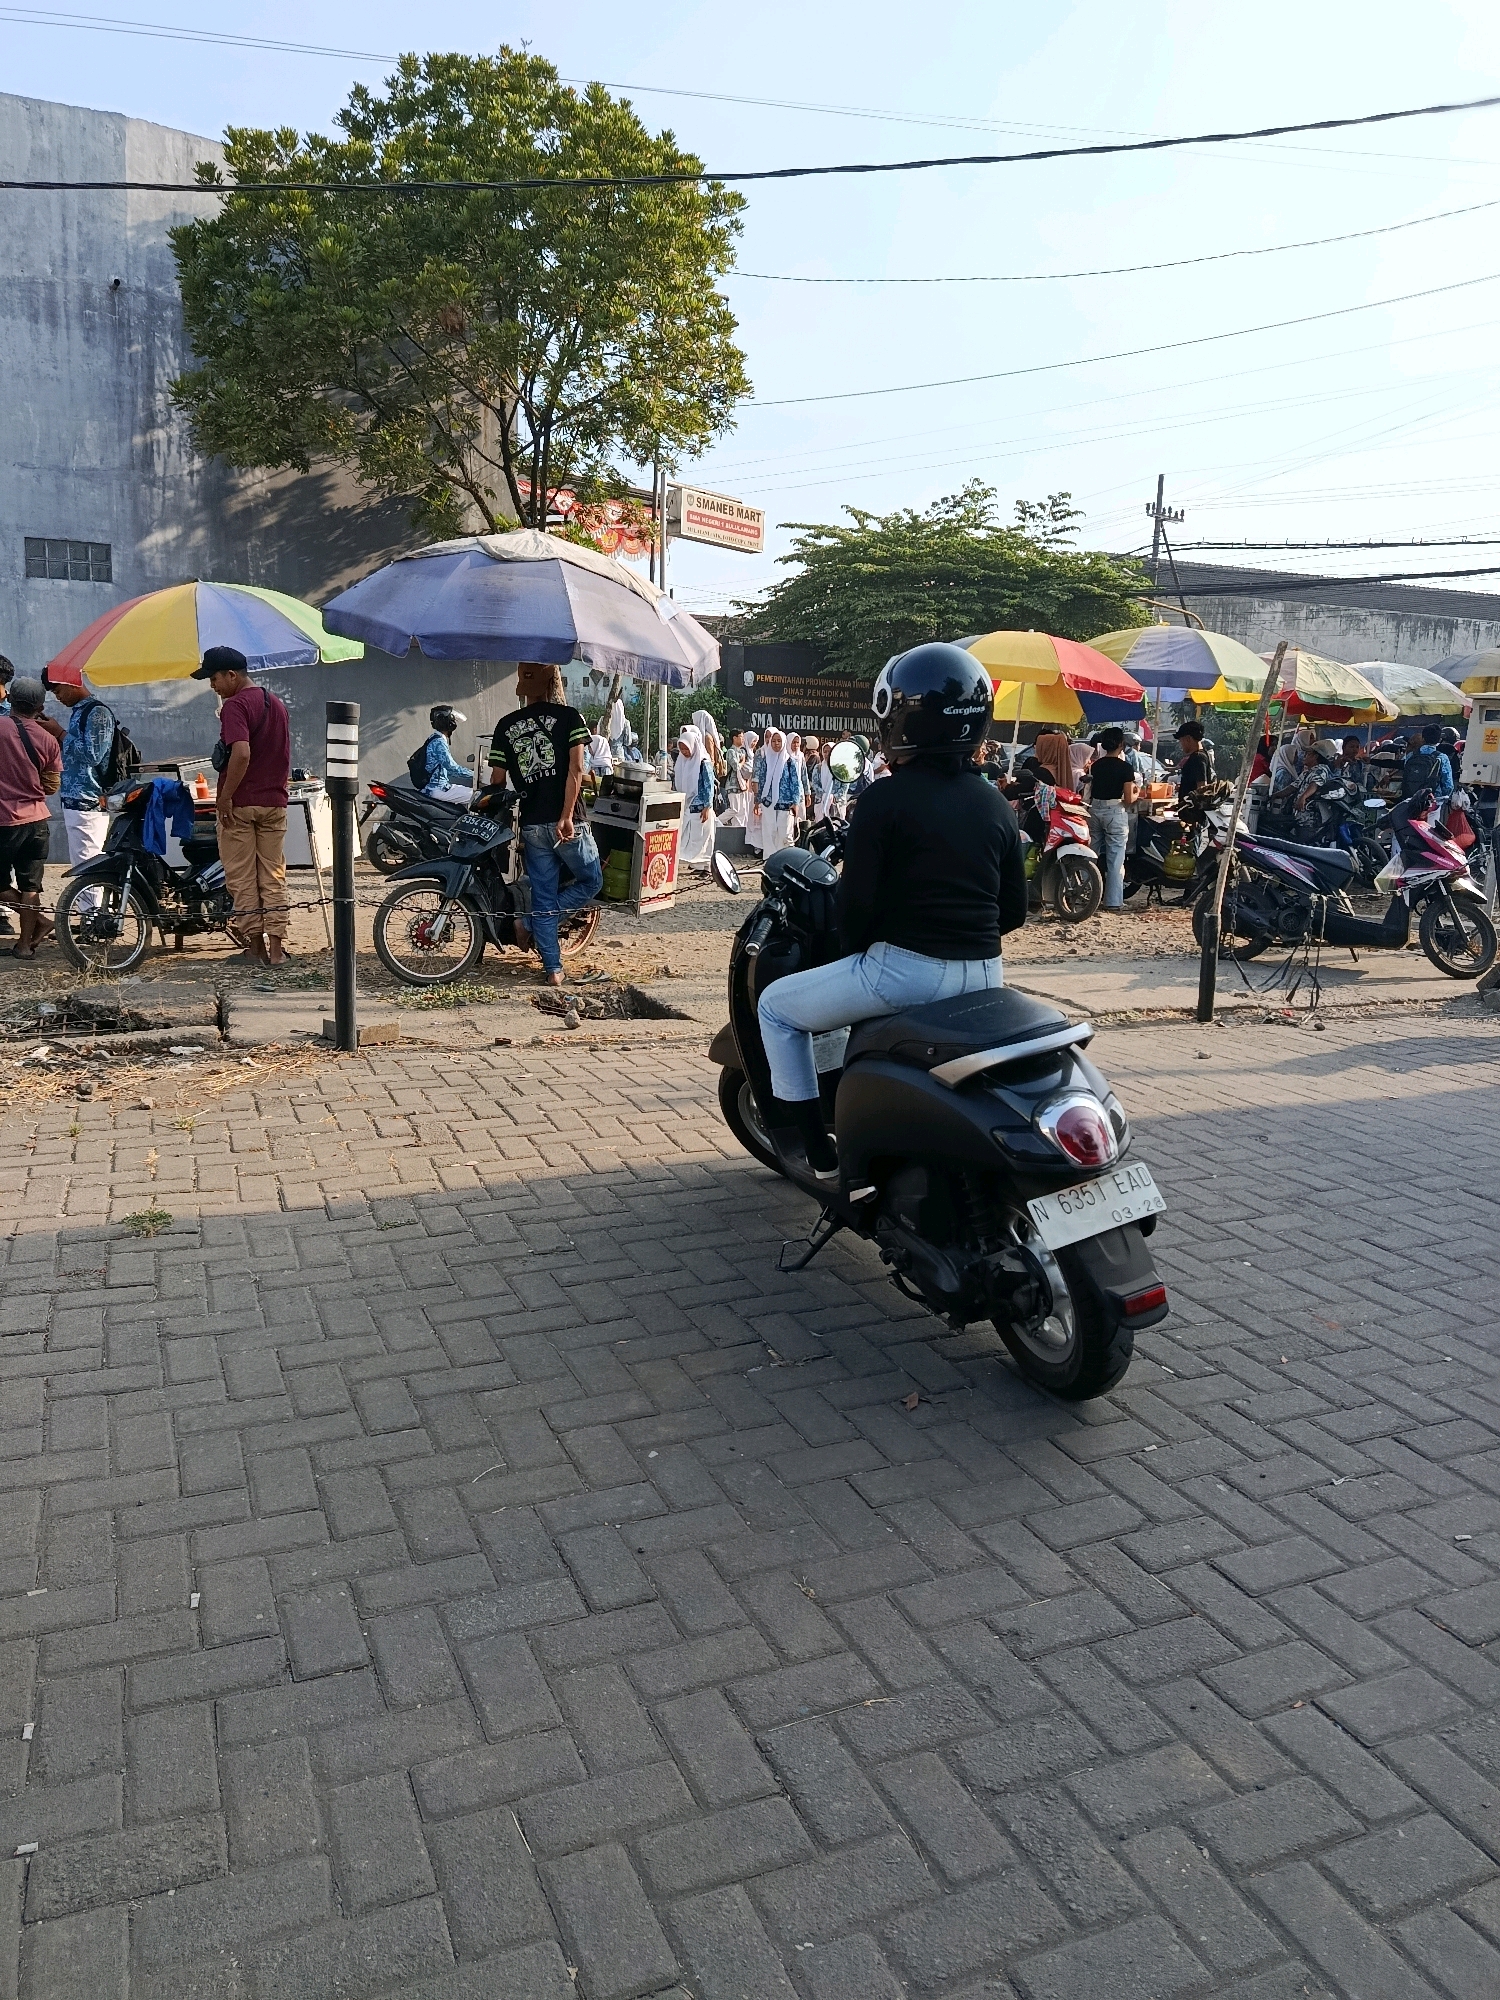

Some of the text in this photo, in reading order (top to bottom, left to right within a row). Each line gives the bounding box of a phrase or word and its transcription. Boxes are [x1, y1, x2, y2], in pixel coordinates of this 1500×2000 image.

[696, 497, 761, 523] SMANEB MART
[689, 513, 701, 522] SMA
[701, 516, 720, 527] NEGERI
[725, 522, 758, 536] BULULAWANG
[756, 674, 870, 689] PEMERINTAHAN PROVINSI JAWA TIMUR
[783, 687, 849, 698] DINAS PENDIDIKAN
[759, 695, 872, 710] UNIT PELAKSANA TEKNIS DINAS
[943, 705, 986, 716] Cargloss
[750, 712, 773, 729] SMA
[779, 713, 819, 730] NEGERI
[480, 820, 498, 833] EAK
[649, 832, 674, 845] WONTON
[648, 841, 672, 854] CHILI OIL
[1031, 1166, 1153, 1223] N 6351 EAD
